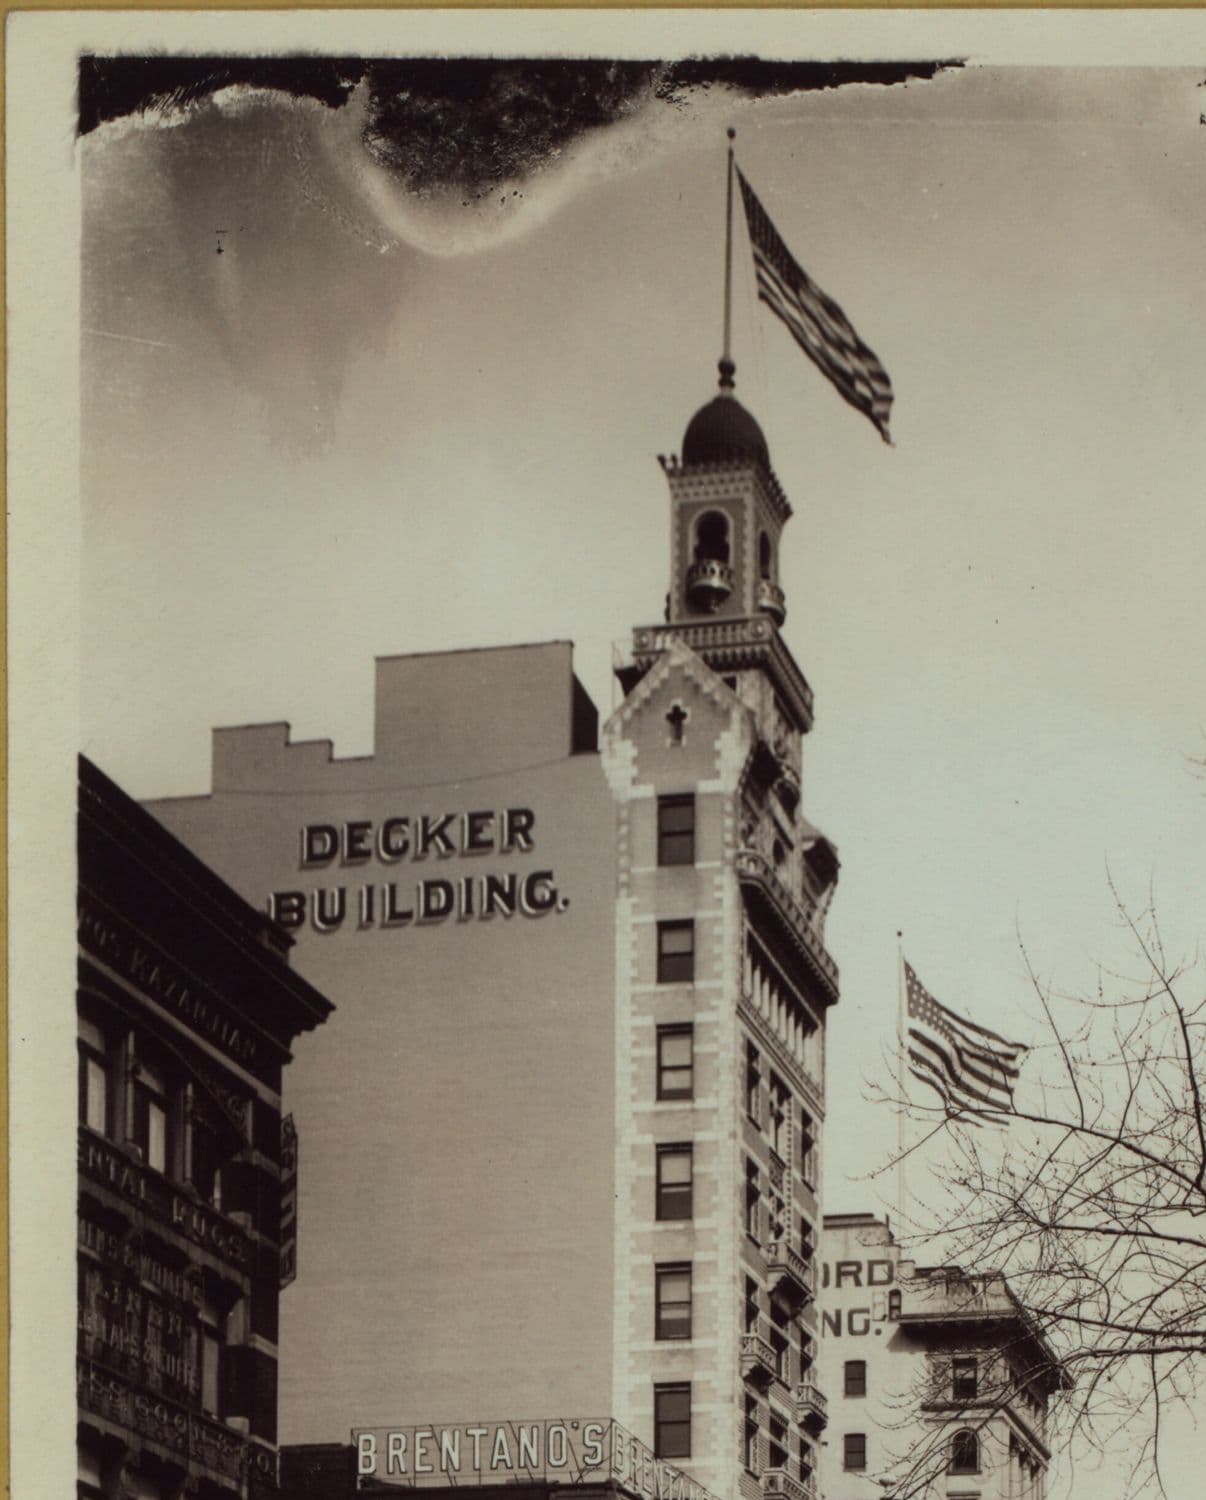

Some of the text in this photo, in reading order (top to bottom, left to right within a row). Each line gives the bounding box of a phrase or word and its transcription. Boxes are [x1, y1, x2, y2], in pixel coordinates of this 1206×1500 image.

[299, 807, 535, 870] DECKER
[267, 872, 570, 932] BUILDING.
[357, 1420, 604, 1475] BRENTANO'S
